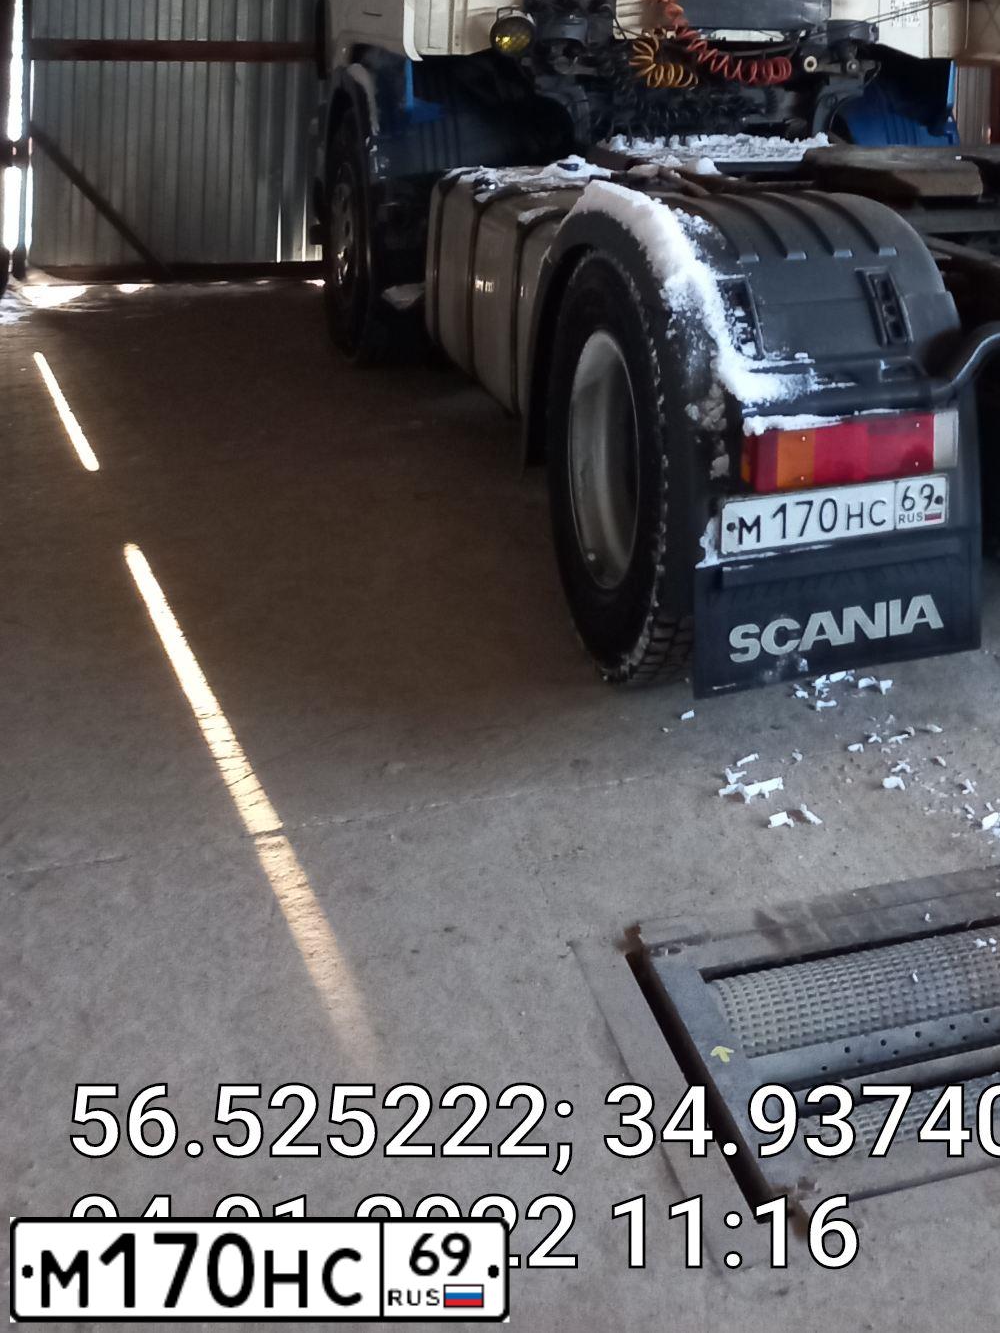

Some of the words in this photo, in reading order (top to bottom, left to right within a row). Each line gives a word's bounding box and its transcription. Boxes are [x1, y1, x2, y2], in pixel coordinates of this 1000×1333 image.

[901, 483, 935, 512] 69
[898, 512, 924, 524] RUS
[728, 594, 945, 663] SCANIA
